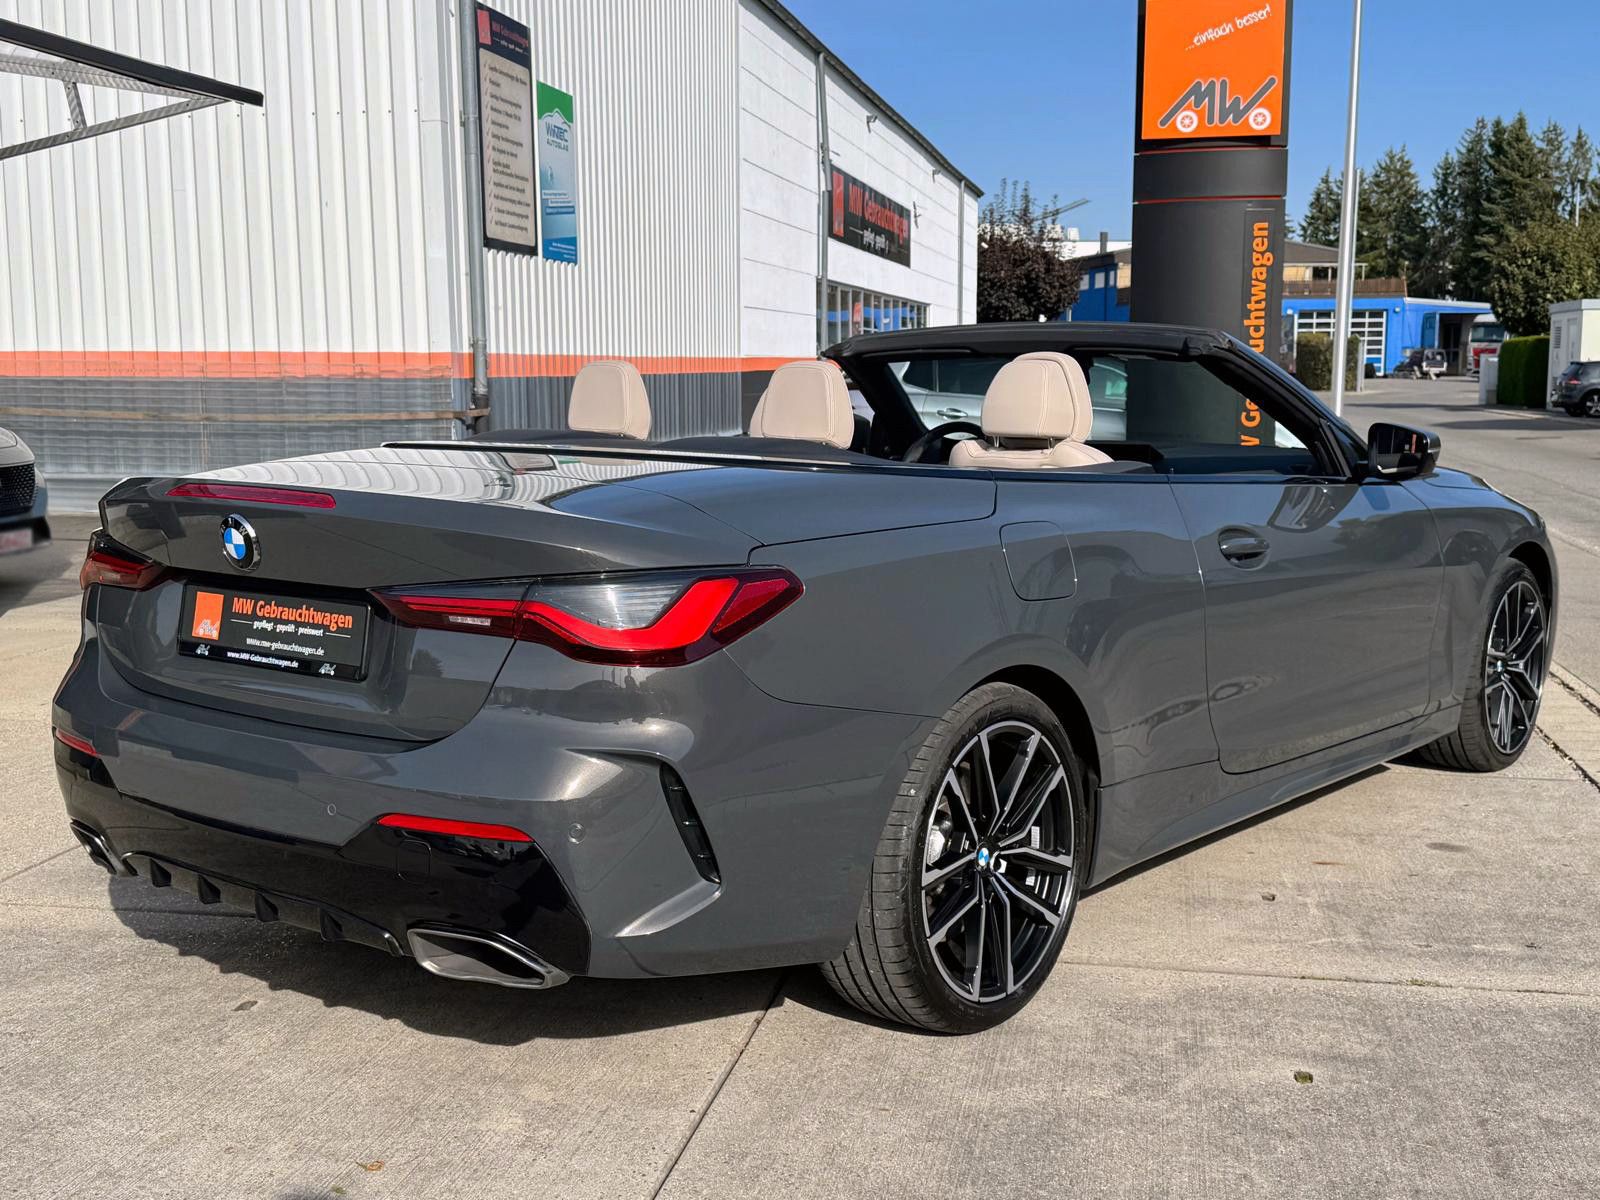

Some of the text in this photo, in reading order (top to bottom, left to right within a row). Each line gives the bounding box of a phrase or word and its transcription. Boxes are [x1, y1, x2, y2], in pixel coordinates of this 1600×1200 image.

[1158, 76, 1277, 128] MW
[1241, 222, 1274, 428] Geuchtwagen
[232, 597, 353, 631] MW Gebrauchtwagen
[253, 620, 324, 637] gepflegt geprüft preiswert
[246, 637, 325, 656] www.mw-gebrauchtwagen.de
